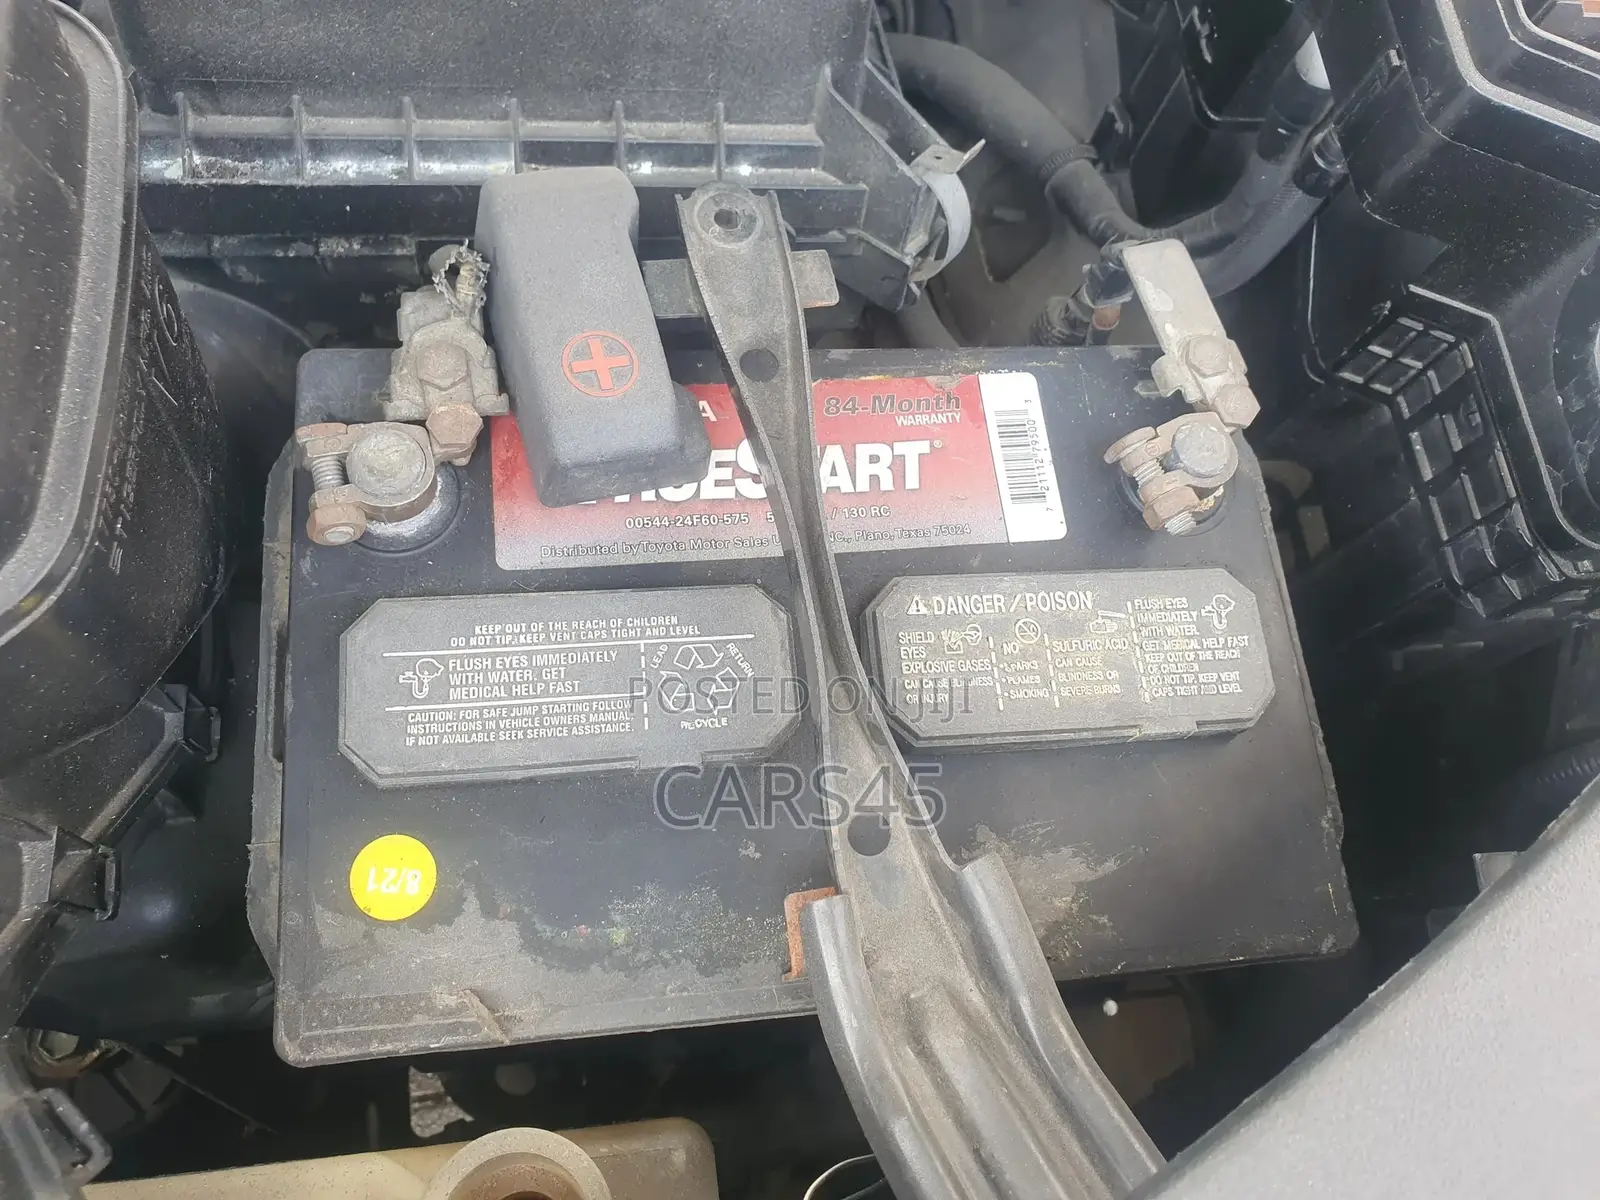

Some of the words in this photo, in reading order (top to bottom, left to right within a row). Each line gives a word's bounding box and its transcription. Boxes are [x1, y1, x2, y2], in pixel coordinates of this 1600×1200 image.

[823, 393, 961, 417] 84-Month
[895, 412, 962, 427] WARRANTY
[1026, 419, 1042, 453] 79500
[1034, 458, 1050, 492] 21112
[625, 513, 749, 529] 00544-24F60-575
[842, 507, 867, 519] 130
[870, 506, 891, 517] RC
[540, 544, 618, 559] Distributed
[623, 542, 640, 555] by
[641, 541, 686, 554] Toyota
[690, 538, 729, 551] Motor
[733, 536, 769, 548] Sales
[855, 530, 894, 542] Plano,
[895, 528, 930, 539] Texas
[933, 523, 971, 538] 75024
[1134, 598, 1164, 610] FLUSH
[1165, 597, 1188, 609] EYES
[475, 623, 501, 635] KEEP
[505, 623, 527, 634] OUT
[531, 622, 545, 633] OF
[548, 620, 568, 631] THE
[572, 618, 606, 630] REACH
[610, 617, 624, 628] OF
[627, 615, 678, 628] CHILDREN
[1137, 610, 1198, 624] IMMEDIATELY
[450, 636, 466, 647] DO
[470, 636, 492, 646] NOT
[519, 633, 546, 644] KEEP
[550, 632, 577, 642] VENT
[580, 629, 608, 641] CAPS
[611, 628, 641, 639] TIGHT
[646, 626, 667, 637] AND
[670, 625, 701, 636] LEVEL
[898, 631, 934, 644] SHIELD
[1140, 625, 1164, 638] WITH
[1165, 624, 1200, 637] WATER.
[1003, 642, 1019, 656] NO
[1052, 639, 1102, 653] SULFURIC
[1105, 638, 1128, 650] ACID
[1142, 639, 1160, 652] GET
[1202, 637, 1224, 649] HELP
[1227, 635, 1249, 648] FAST
[650, 643, 668, 669] LEAD
[726, 642, 755, 678] RETURN
[900, 646, 926, 659] EYES
[1145, 653, 1165, 664] KEEP
[1167, 652, 1182, 663] OUT
[1185, 651, 1196, 662] OF
[1197, 650, 1214, 661] THE
[1215, 649, 1241, 660] REACH
[448, 657, 492, 672] FLUSH
[496, 655, 528, 669] EYES
[532, 651, 618, 667] IMMEDIATELY
[902, 660, 956, 674] EXPLOSIVE
[958, 658, 991, 672] GASES
[1055, 658, 1073, 668] CAN
[1076, 656, 1102, 667] CAUSE
[1147, 664, 1158, 675] OF
[1160, 662, 1200, 674] CHILDREN
[449, 672, 483, 686] WITH
[487, 669, 537, 683] WATER.
[542, 667, 567, 680] GET
[1058, 671, 1104, 682] BLINDNESS
[1106, 670, 1119, 680] OR
[1150, 675, 1162, 686] DO
[1164, 674, 1180, 685] NOT
[1198, 672, 1218, 683] KEEP
[1219, 671, 1240, 682] VENT
[449, 685, 508, 700] MEDICAL
[512, 683, 545, 697] HELP
[549, 681, 580, 694] FAST
[1009, 688, 1049, 699] SMOKING
[1093, 683, 1121, 694] BURNS
[1152, 686, 1174, 697] CAPS
[1175, 685, 1198, 696] TIGHT
[1218, 683, 1243, 694] LEVEL
[407, 711, 457, 723] CAUTION:
[459, 710, 480, 720] FOR
[483, 708, 508, 719] SAFE
[510, 706, 539, 717] JUMP
[541, 702, 590, 715] STARTING
[592, 699, 632, 712] FOLLOW
[407, 721, 482, 734] INSTRUCTIONS
[485, 719, 496, 730] IN
[499, 717, 541, 729] VEHICLE
[543, 714, 587, 726] OWNERS
[589, 710, 634, 723] MANUAL.
[681, 717, 728, 730] RECYCLE
[405, 736, 416, 746] IF
[418, 734, 439, 745] NOT
[442, 731, 496, 744] AVAILABLE
[498, 729, 524, 741] SEEK
[527, 727, 569, 739] SERVICE
[571, 723, 635, 736] ASSISTANCE.
[366, 866, 422, 896] 8/21
